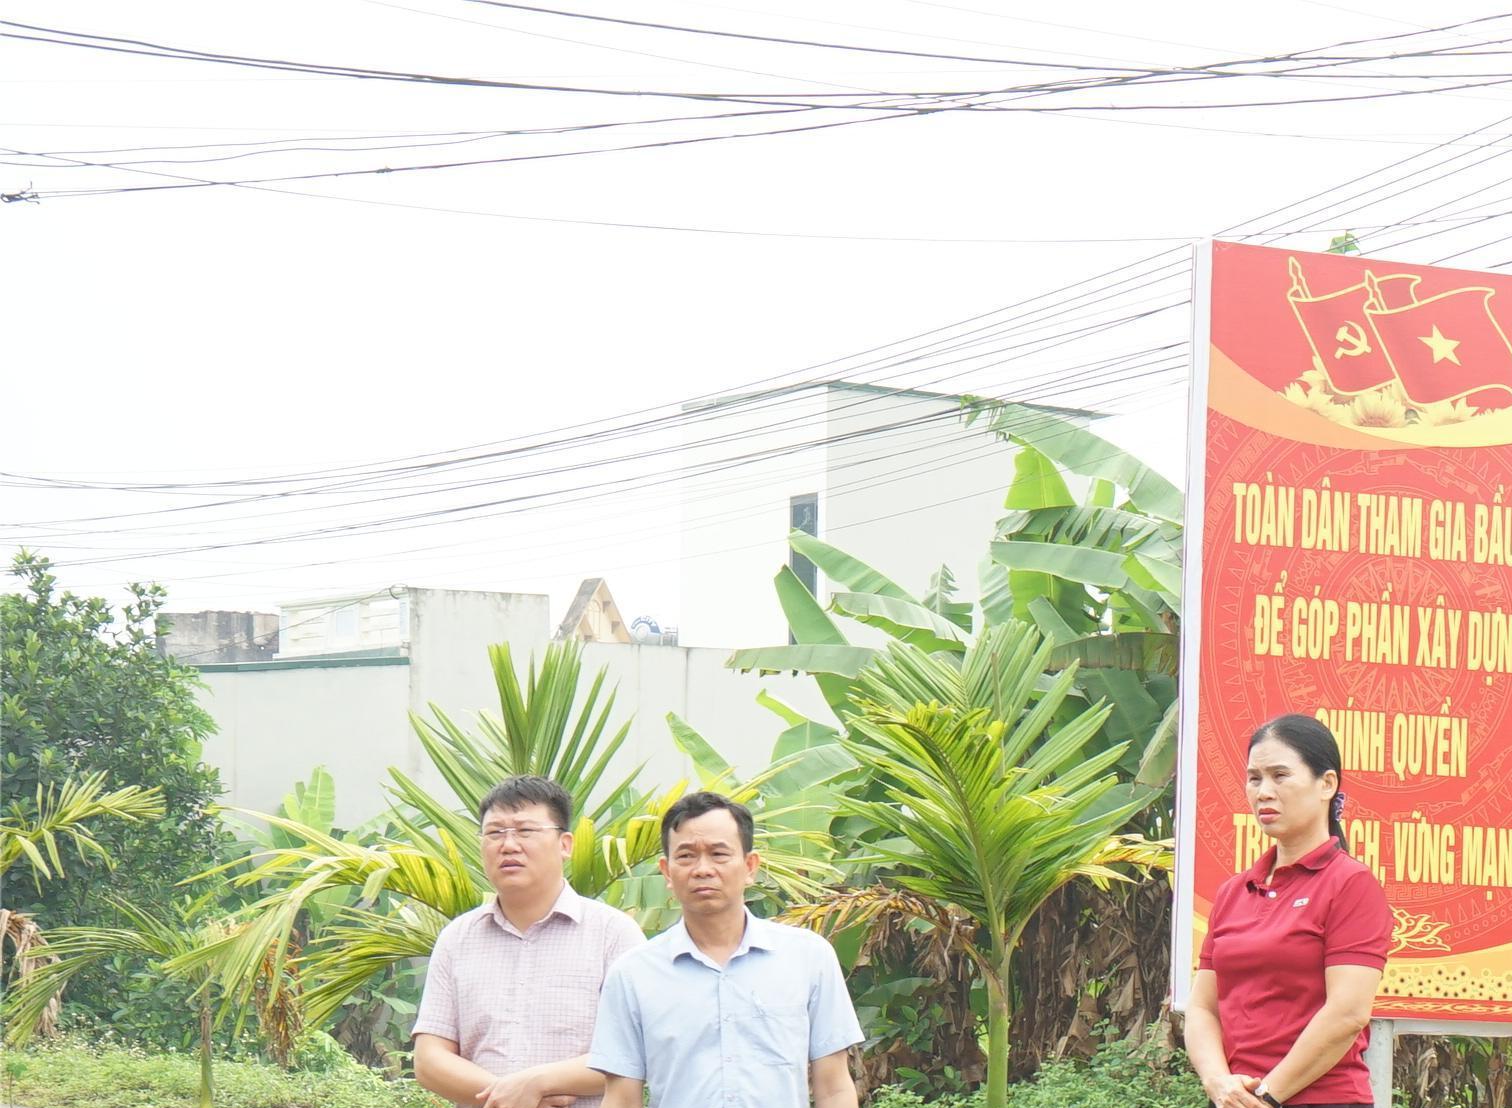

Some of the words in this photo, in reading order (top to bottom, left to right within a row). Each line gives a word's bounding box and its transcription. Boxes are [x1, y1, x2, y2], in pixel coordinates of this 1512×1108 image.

[1233, 471, 1295, 548] TOÀN
[1302, 476, 1350, 552] DÂN
[1357, 493, 1422, 558] THAM
[1429, 499, 1467, 562] GIA
[1254, 570, 1287, 656] ĐỂ
[1291, 585, 1340, 660] GÓP
[1345, 582, 1410, 665] PHẦN
[1415, 595, 1462, 669] XÂY
[1392, 696, 1468, 781] QUYỀN
[1394, 810, 1456, 885] VỮNG
